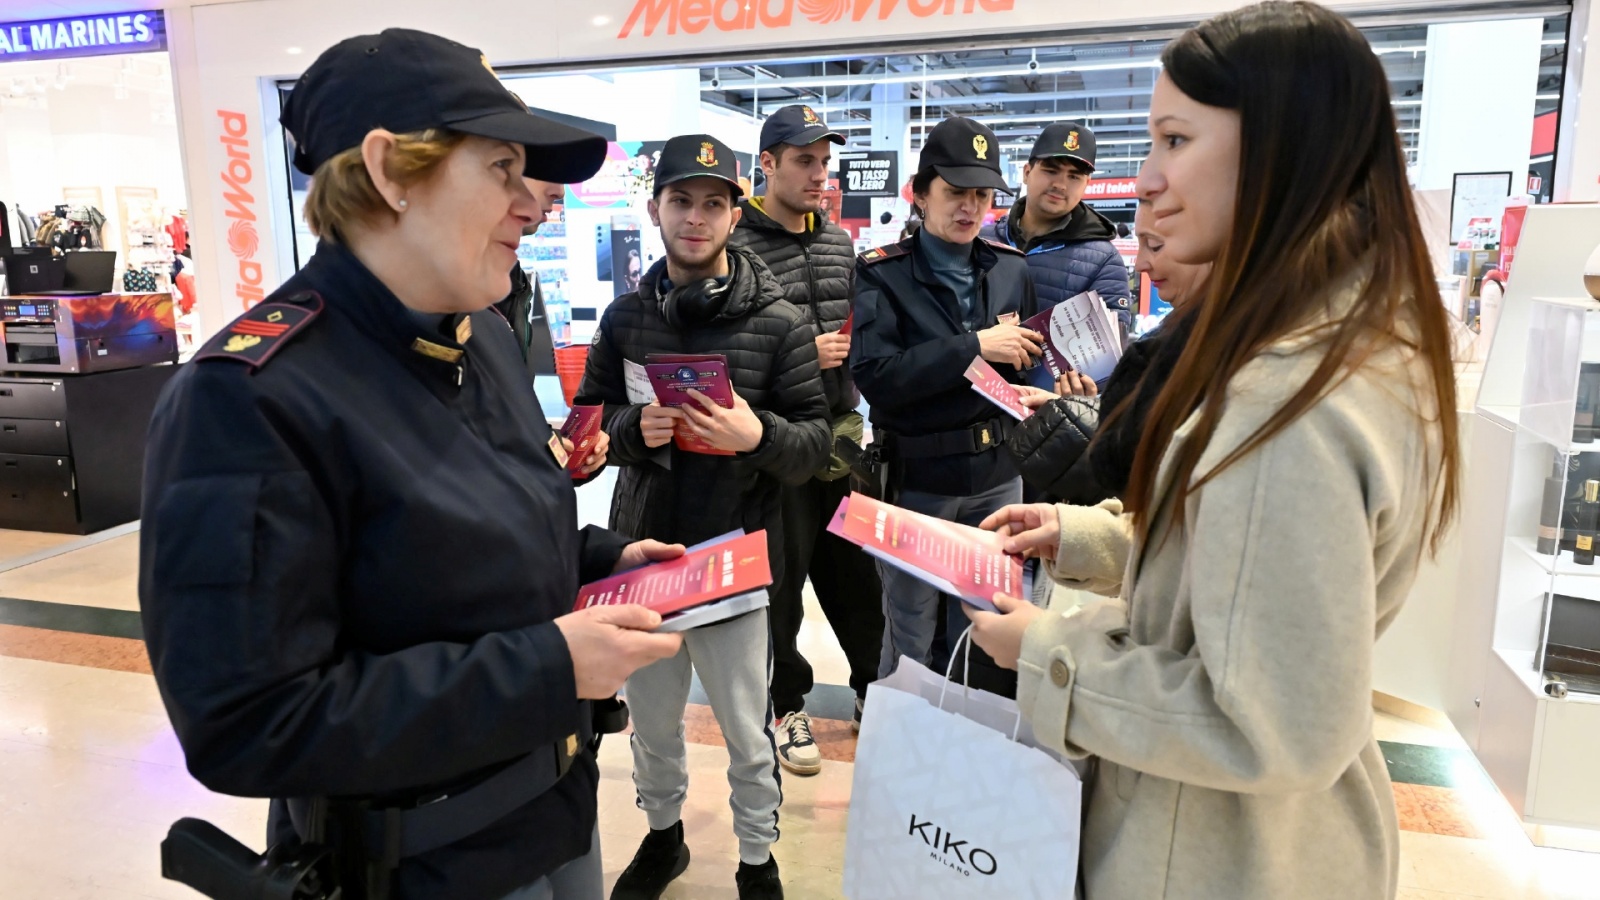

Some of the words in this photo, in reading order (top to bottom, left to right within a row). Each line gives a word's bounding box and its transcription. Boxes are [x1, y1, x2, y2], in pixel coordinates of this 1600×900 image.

[30, 14, 149, 50] MARINES
[217, 109, 257, 222] World
[849, 160, 870, 169] TUTTO
[870, 160, 890, 168] VERO
[862, 170, 889, 181] TASSO
[861, 180, 885, 190] ZERO
[236, 260, 264, 312] dia
[908, 813, 998, 876] KIKO
[930, 851, 970, 877] MILANO
